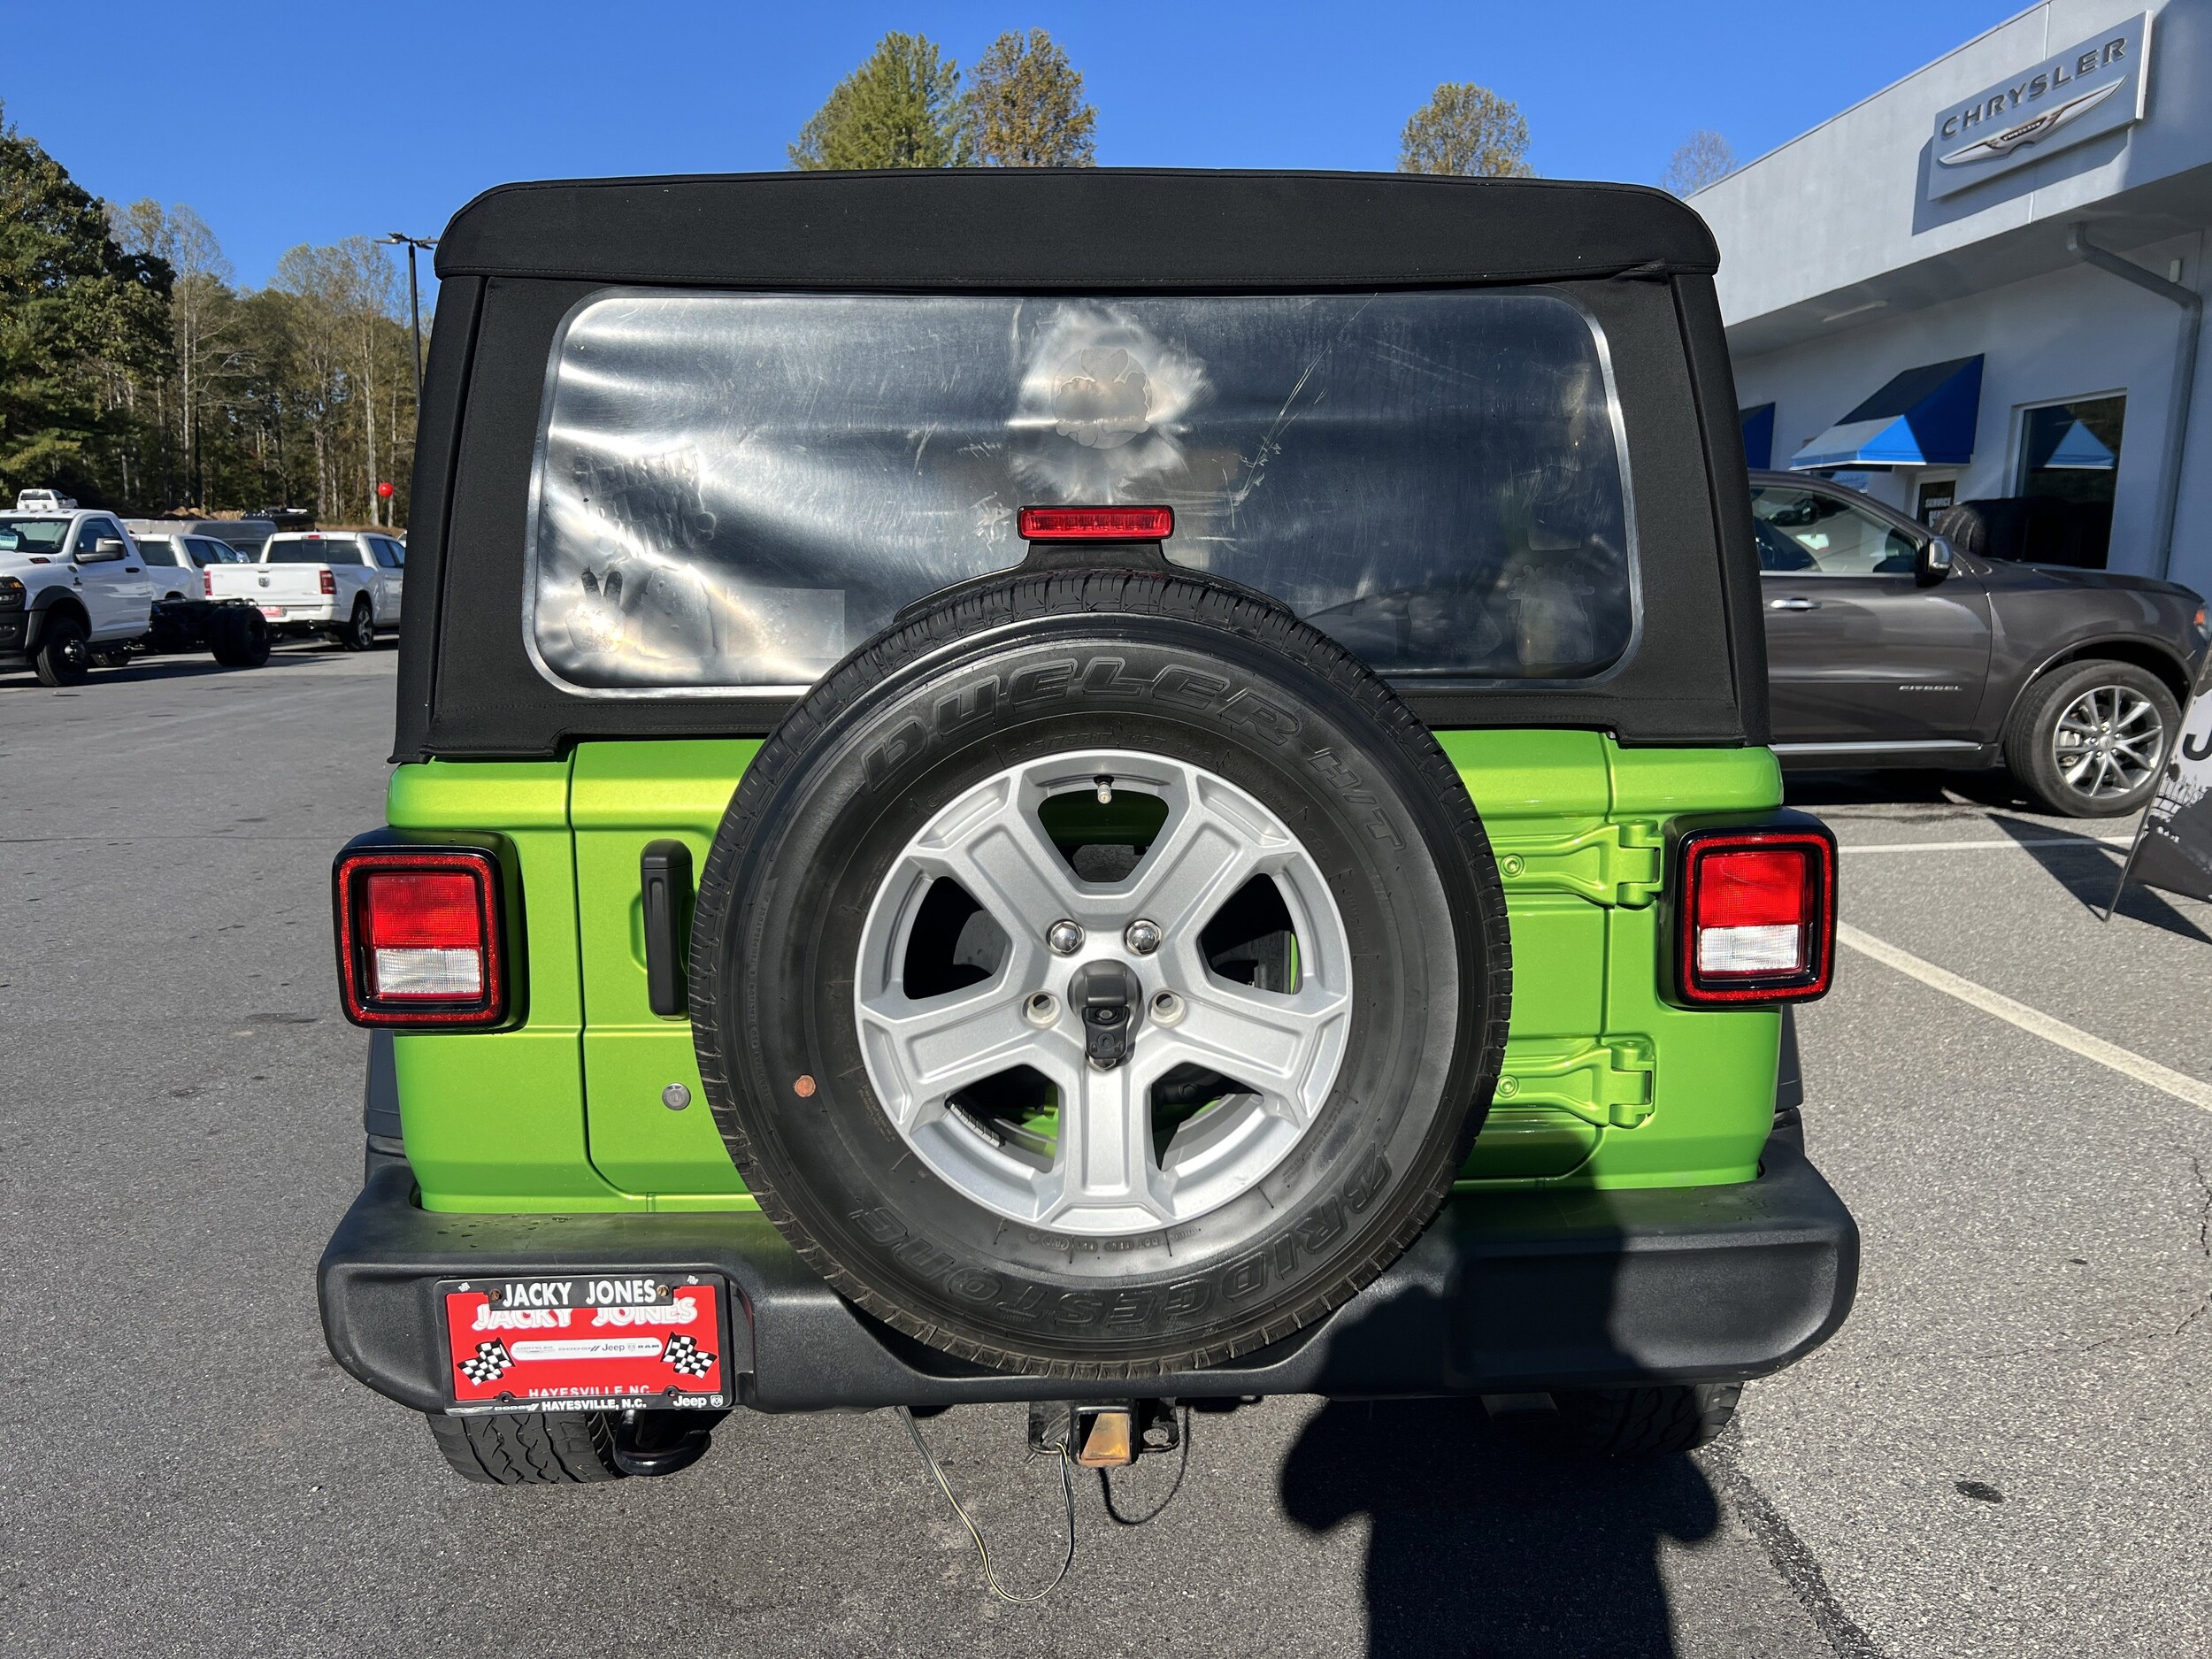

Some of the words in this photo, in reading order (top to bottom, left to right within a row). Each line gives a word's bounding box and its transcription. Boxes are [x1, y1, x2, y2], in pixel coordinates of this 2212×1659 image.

[1941, 37, 2127, 138] CHRYSLER
[862, 657, 1303, 793] DUELER
[1307, 748, 1407, 852] H/T
[848, 1141, 1393, 1326] BRIDGESTONE
[502, 1282, 572, 1308] JACKY
[586, 1279, 656, 1306] JONES
[602, 1342, 626, 1353] Jeep
[541, 1398, 619, 1411] HAYESVILLE,
[621, 1397, 648, 1409] N.C.
[672, 1394, 707, 1409] Jeep
